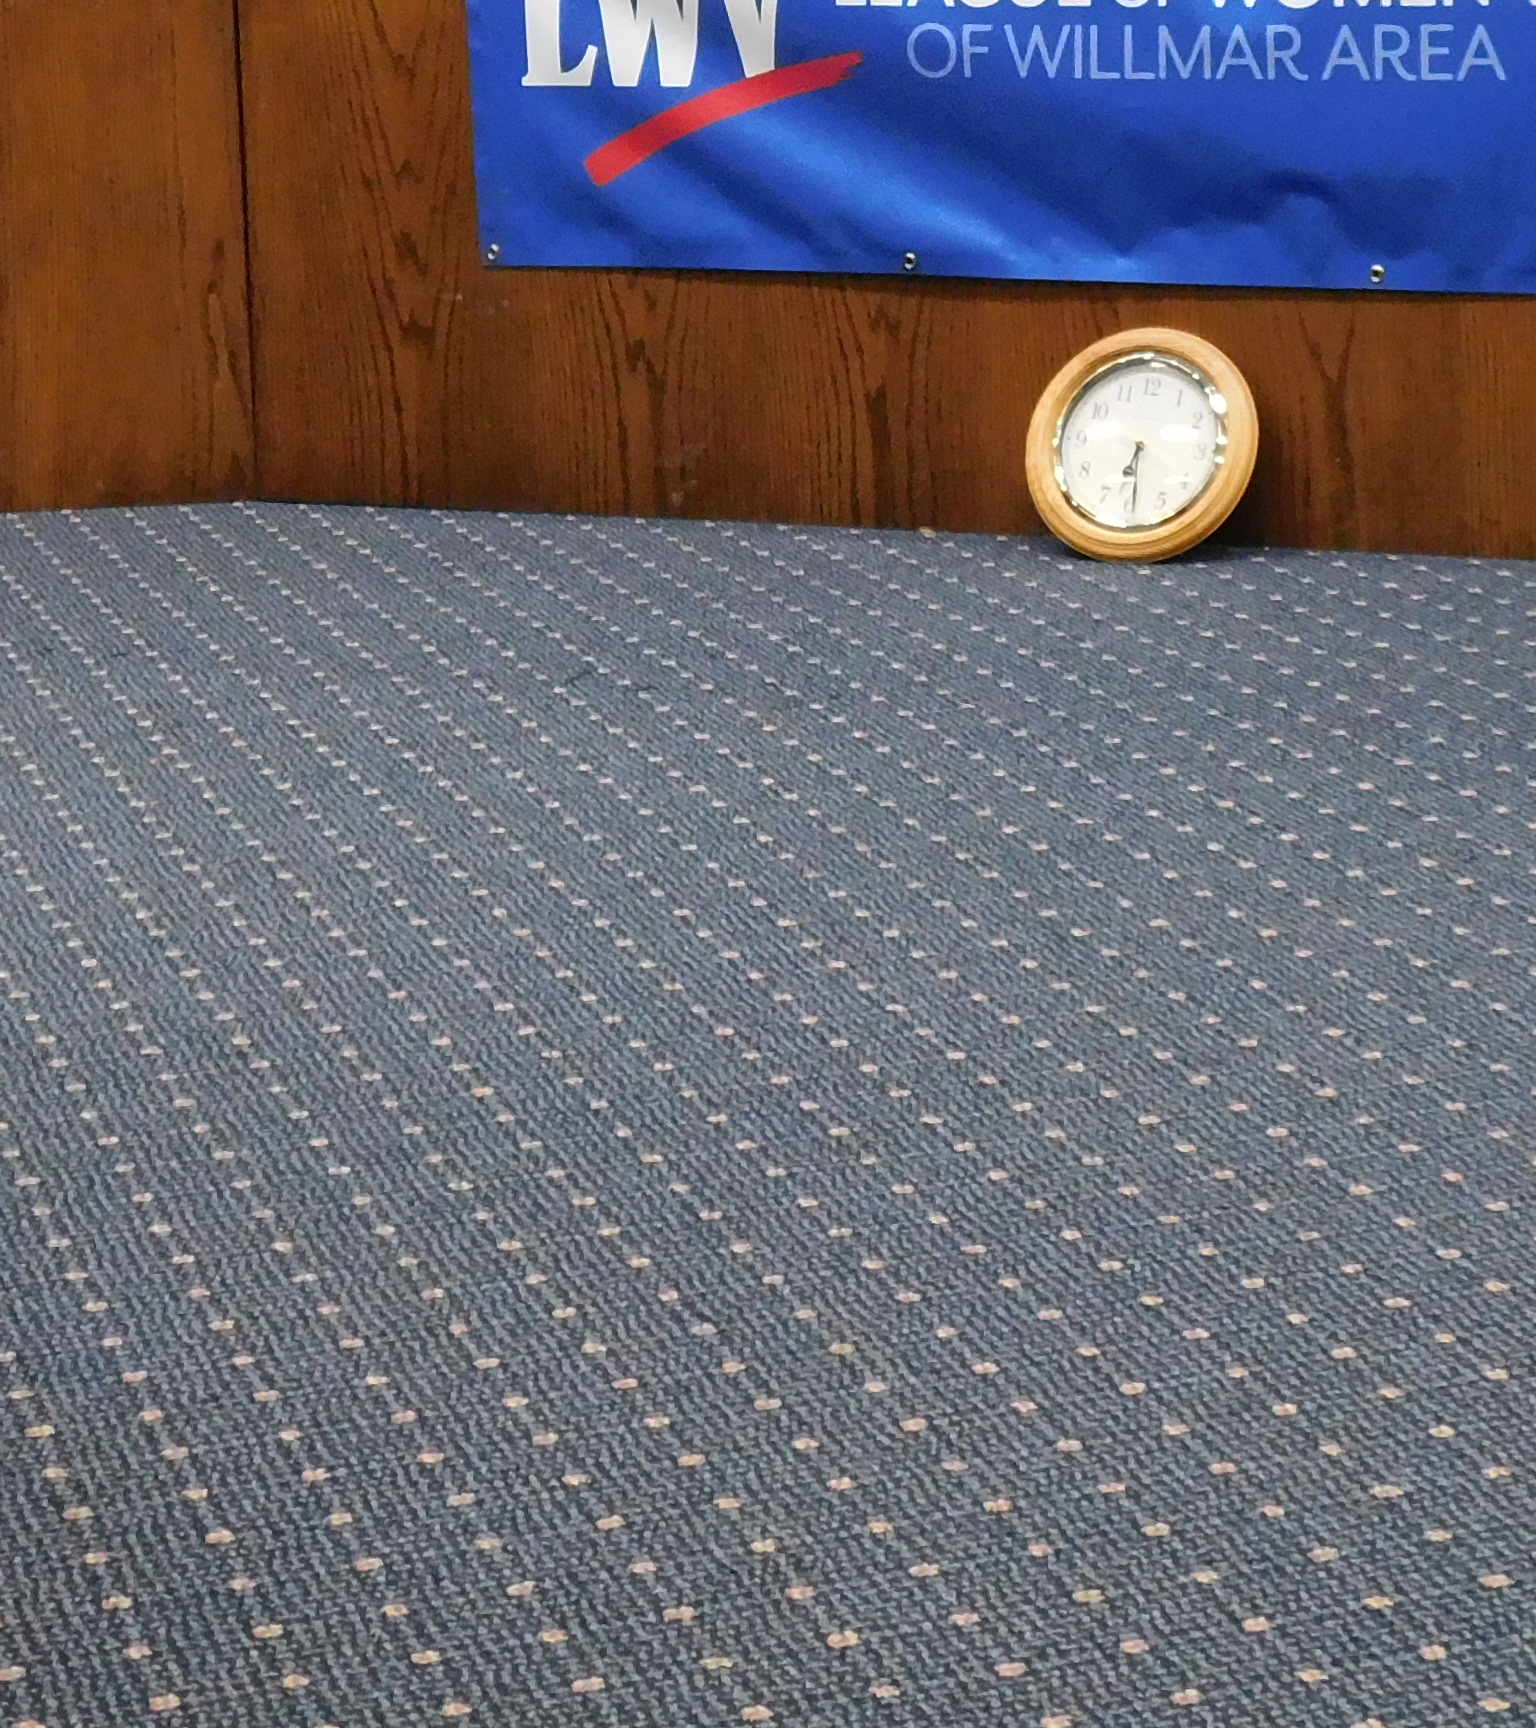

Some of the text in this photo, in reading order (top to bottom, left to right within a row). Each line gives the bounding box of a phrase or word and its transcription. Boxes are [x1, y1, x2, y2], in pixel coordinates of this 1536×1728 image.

[906, 22, 1507, 82] OF WILLMAR AREA
[1116, 384, 1133, 403] 11
[1143, 377, 1162, 397] 12
[1176, 389, 1184, 406] 1
[1091, 402, 1109, 420] 10
[1191, 411, 1204, 429] 2
[1099, 486, 1111, 504] 7
[1153, 491, 1167, 510] 5
